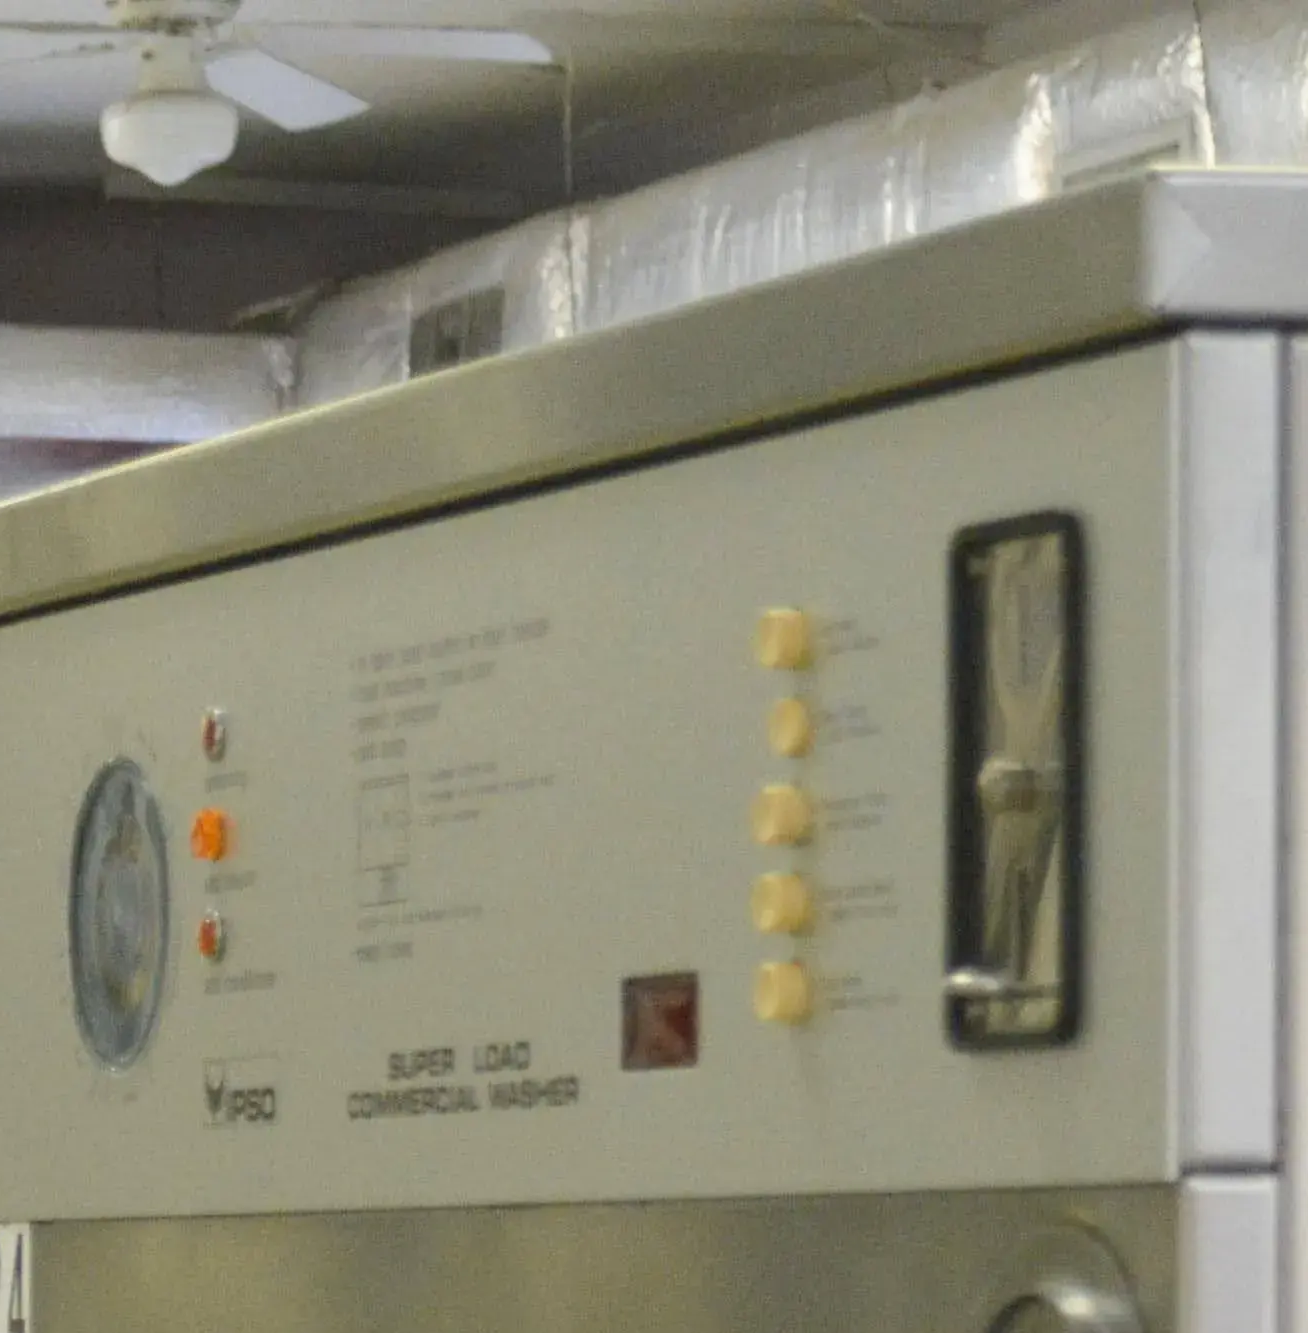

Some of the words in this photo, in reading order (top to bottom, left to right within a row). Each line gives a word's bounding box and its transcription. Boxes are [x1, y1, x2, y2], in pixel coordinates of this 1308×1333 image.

[387, 1047, 455, 1081] SUPER
[473, 1040, 532, 1075] LOAD
[347, 1086, 481, 1120] COMMERCIAL
[489, 1074, 580, 1110] WASHER
